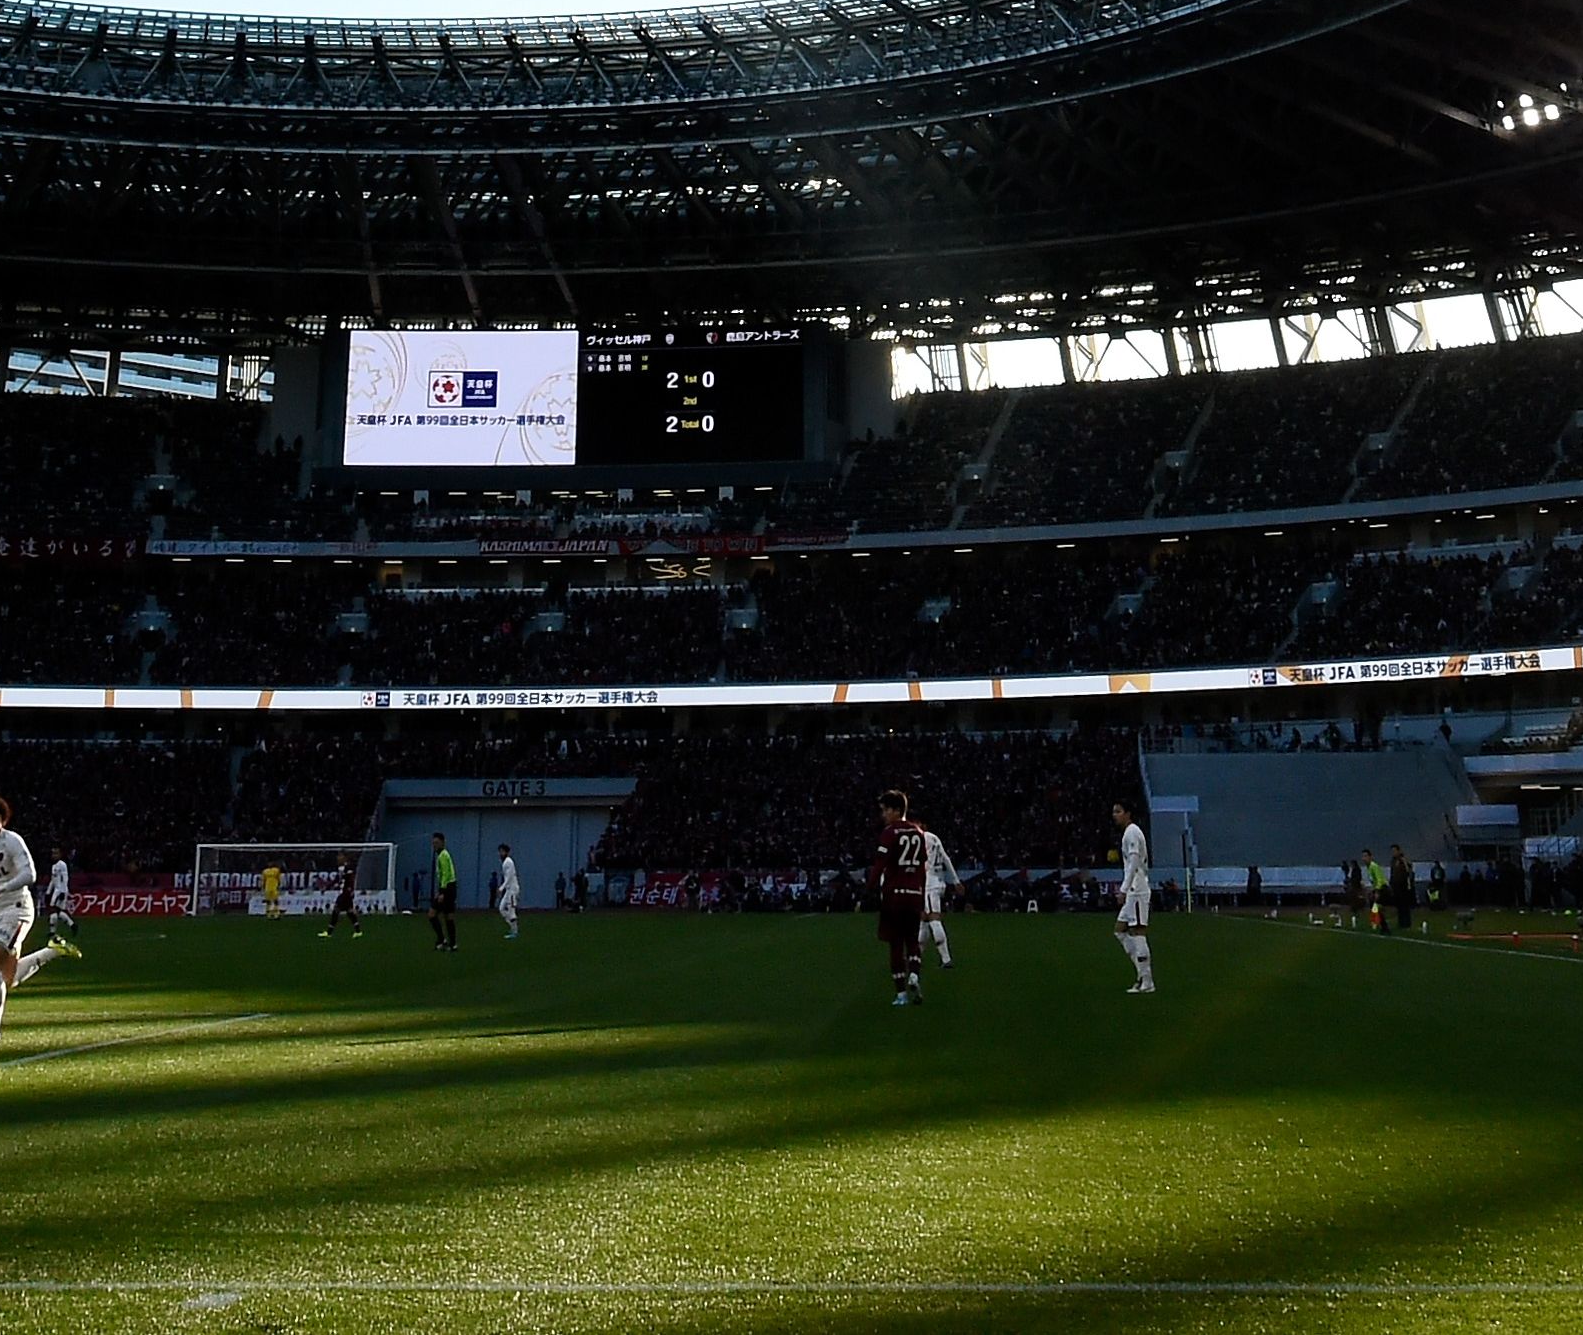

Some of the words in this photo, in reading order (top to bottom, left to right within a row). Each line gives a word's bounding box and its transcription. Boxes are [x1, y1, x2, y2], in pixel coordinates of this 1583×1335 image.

[666, 372, 679, 389] 2
[684, 375, 698, 384] 1st
[702, 371, 715, 388] 0
[683, 396, 698, 406] 2nd
[356, 414, 388, 426] 天皇杯
[390, 415, 412, 426] JFA
[416, 414, 565, 426] 第99回全日本サッカー選手権大会
[666, 416, 679, 433] 2
[681, 419, 700, 429] Total
[701, 415, 715, 433] 0
[1289, 667, 1326, 683] 天皇杯
[1329, 664, 1356, 680] JFA
[1360, 653, 1541, 679] 第99回全日本サッカー選手権大会
[403, 692, 440, 706] 天皇杯
[443, 693, 471, 706] JFA
[476, 691, 659, 706] 第99回全日本サッカー選手権大会
[482, 780, 530, 796] GATE
[536, 780, 546, 796] 3
[898, 834, 921, 866] 22
[81, 893, 192, 914] アイリスオーヤマ
